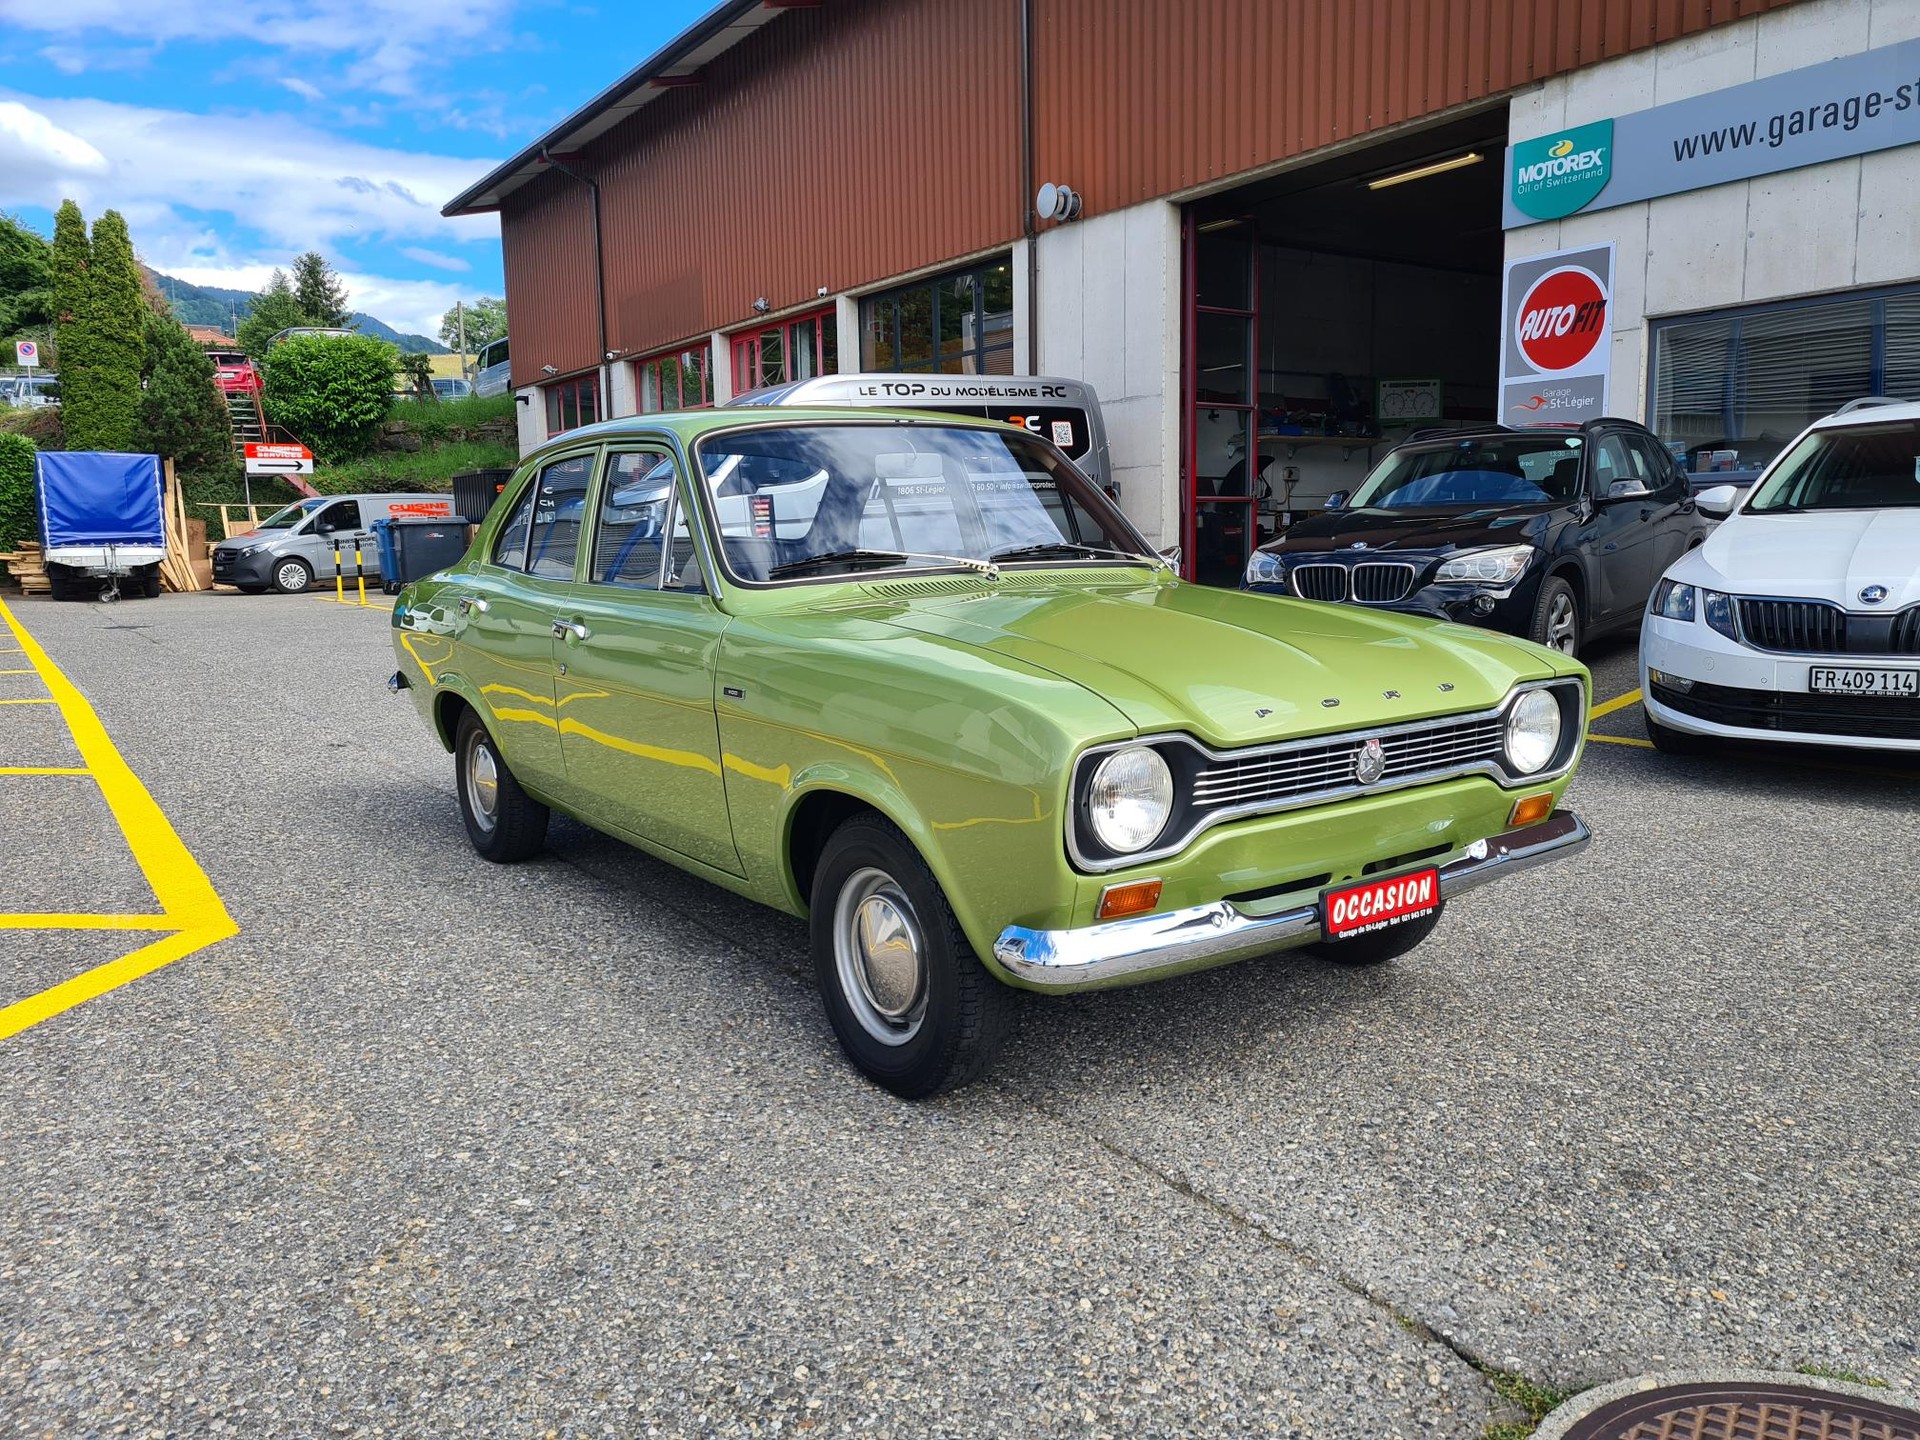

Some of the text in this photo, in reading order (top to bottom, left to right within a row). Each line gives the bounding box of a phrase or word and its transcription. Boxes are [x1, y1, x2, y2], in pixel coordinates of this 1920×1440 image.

[1518, 148, 1603, 185] MOTOREX
[1517, 166, 1603, 195] Oil of Switzerland
[1521, 299, 1608, 341] AUTOFIT
[859, 383, 1067, 398] LE TOP DU MODÉLISME RC
[1542, 387, 1572, 400] Garage
[1549, 395, 1595, 410] St-Légier
[388, 502, 449, 512] CUISINE
[1880, 673, 1914, 691] 114
[1255, 682, 1455, 719] FORD
[1333, 876, 1431, 924] OCCASION
[1338, 928, 1358, 939] Garage
[1358, 925, 1365, 933] de
[1401, 914, 1411, 922] 021
